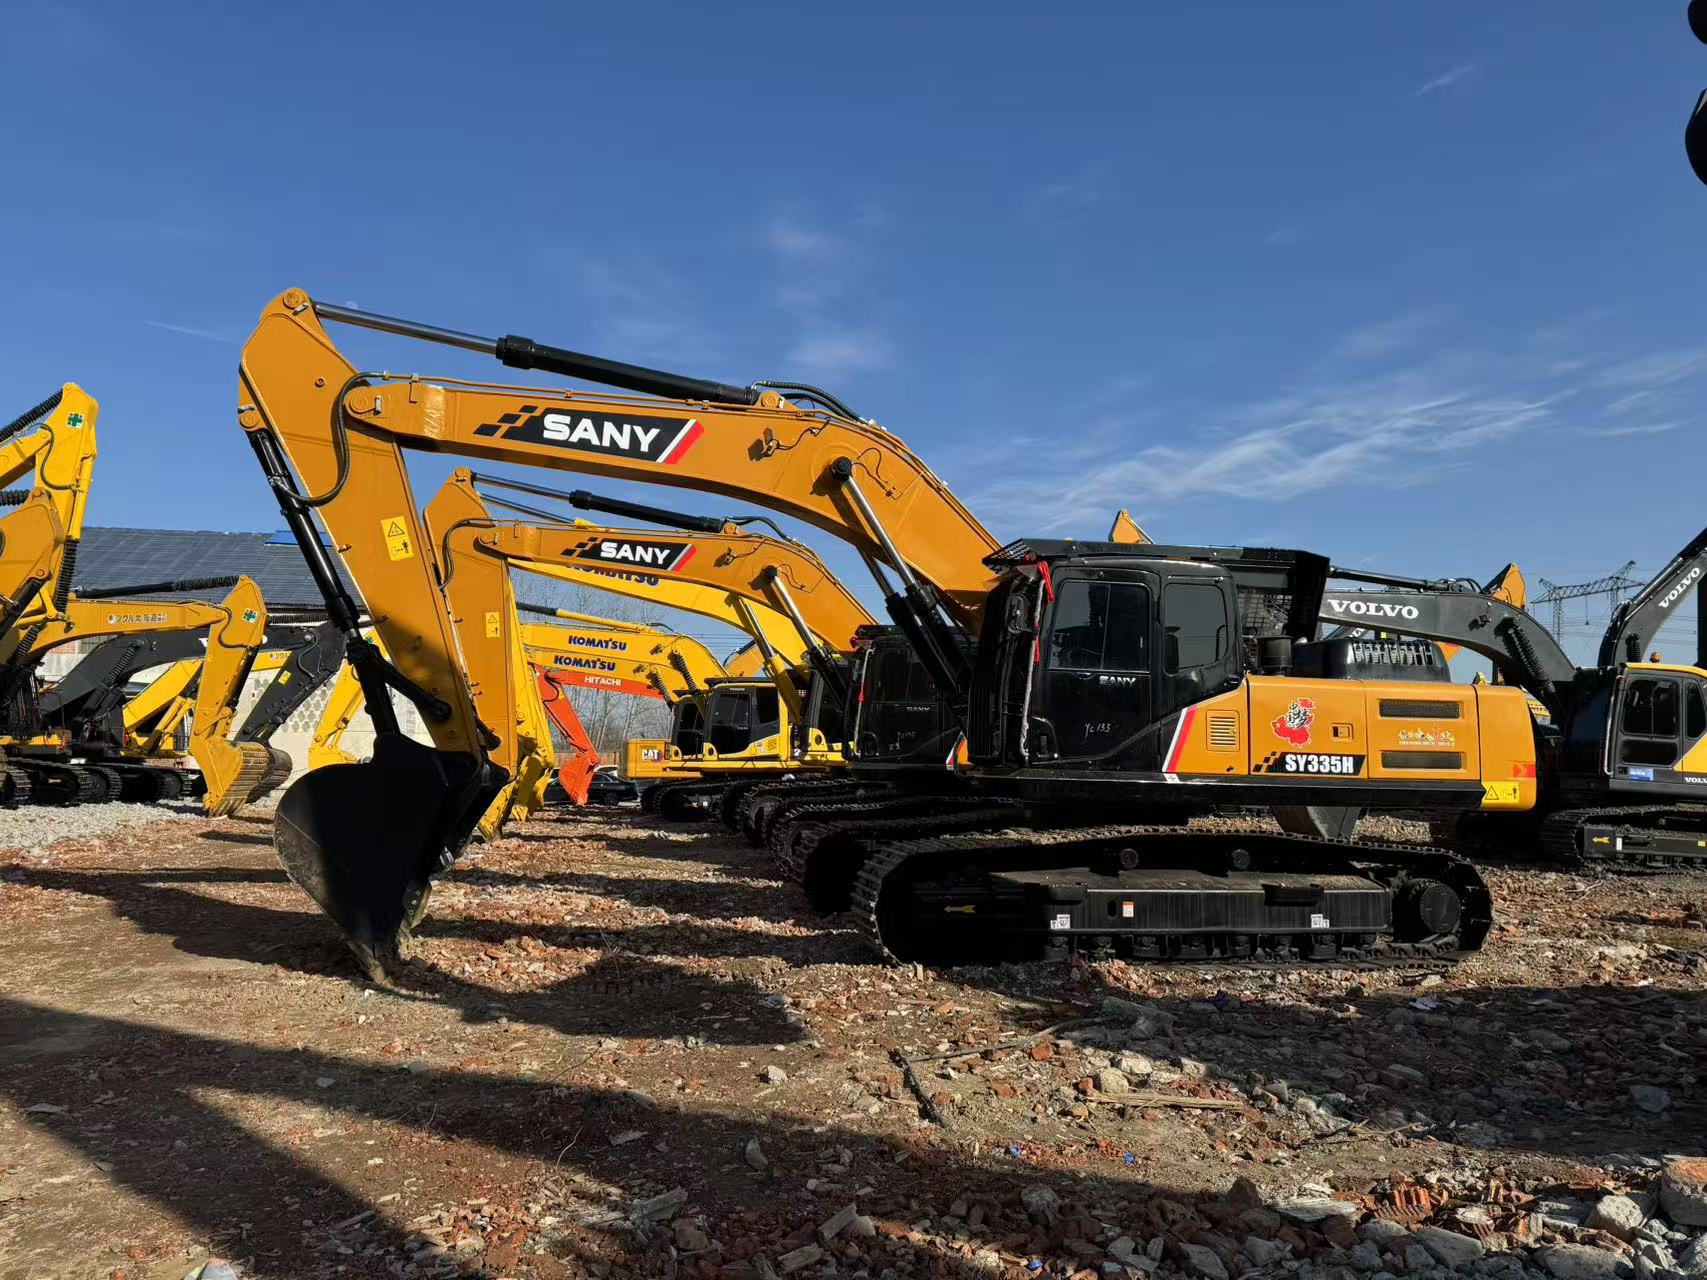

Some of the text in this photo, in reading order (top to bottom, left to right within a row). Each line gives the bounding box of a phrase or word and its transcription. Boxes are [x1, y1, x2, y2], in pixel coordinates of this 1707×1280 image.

[543, 413, 660, 452] SANY
[600, 542, 672, 564] SANY
[1658, 567, 1701, 608] VOLVO
[1327, 599, 1420, 619] VOLVO
[568, 634, 628, 652] KOMATSU
[553, 655, 617, 672] KOMATSU
[584, 676, 622, 687] HITACHI
[1098, 675, 1137, 687] SANY
[641, 749, 659, 760] CAT
[1284, 754, 1354, 774] SY335H
